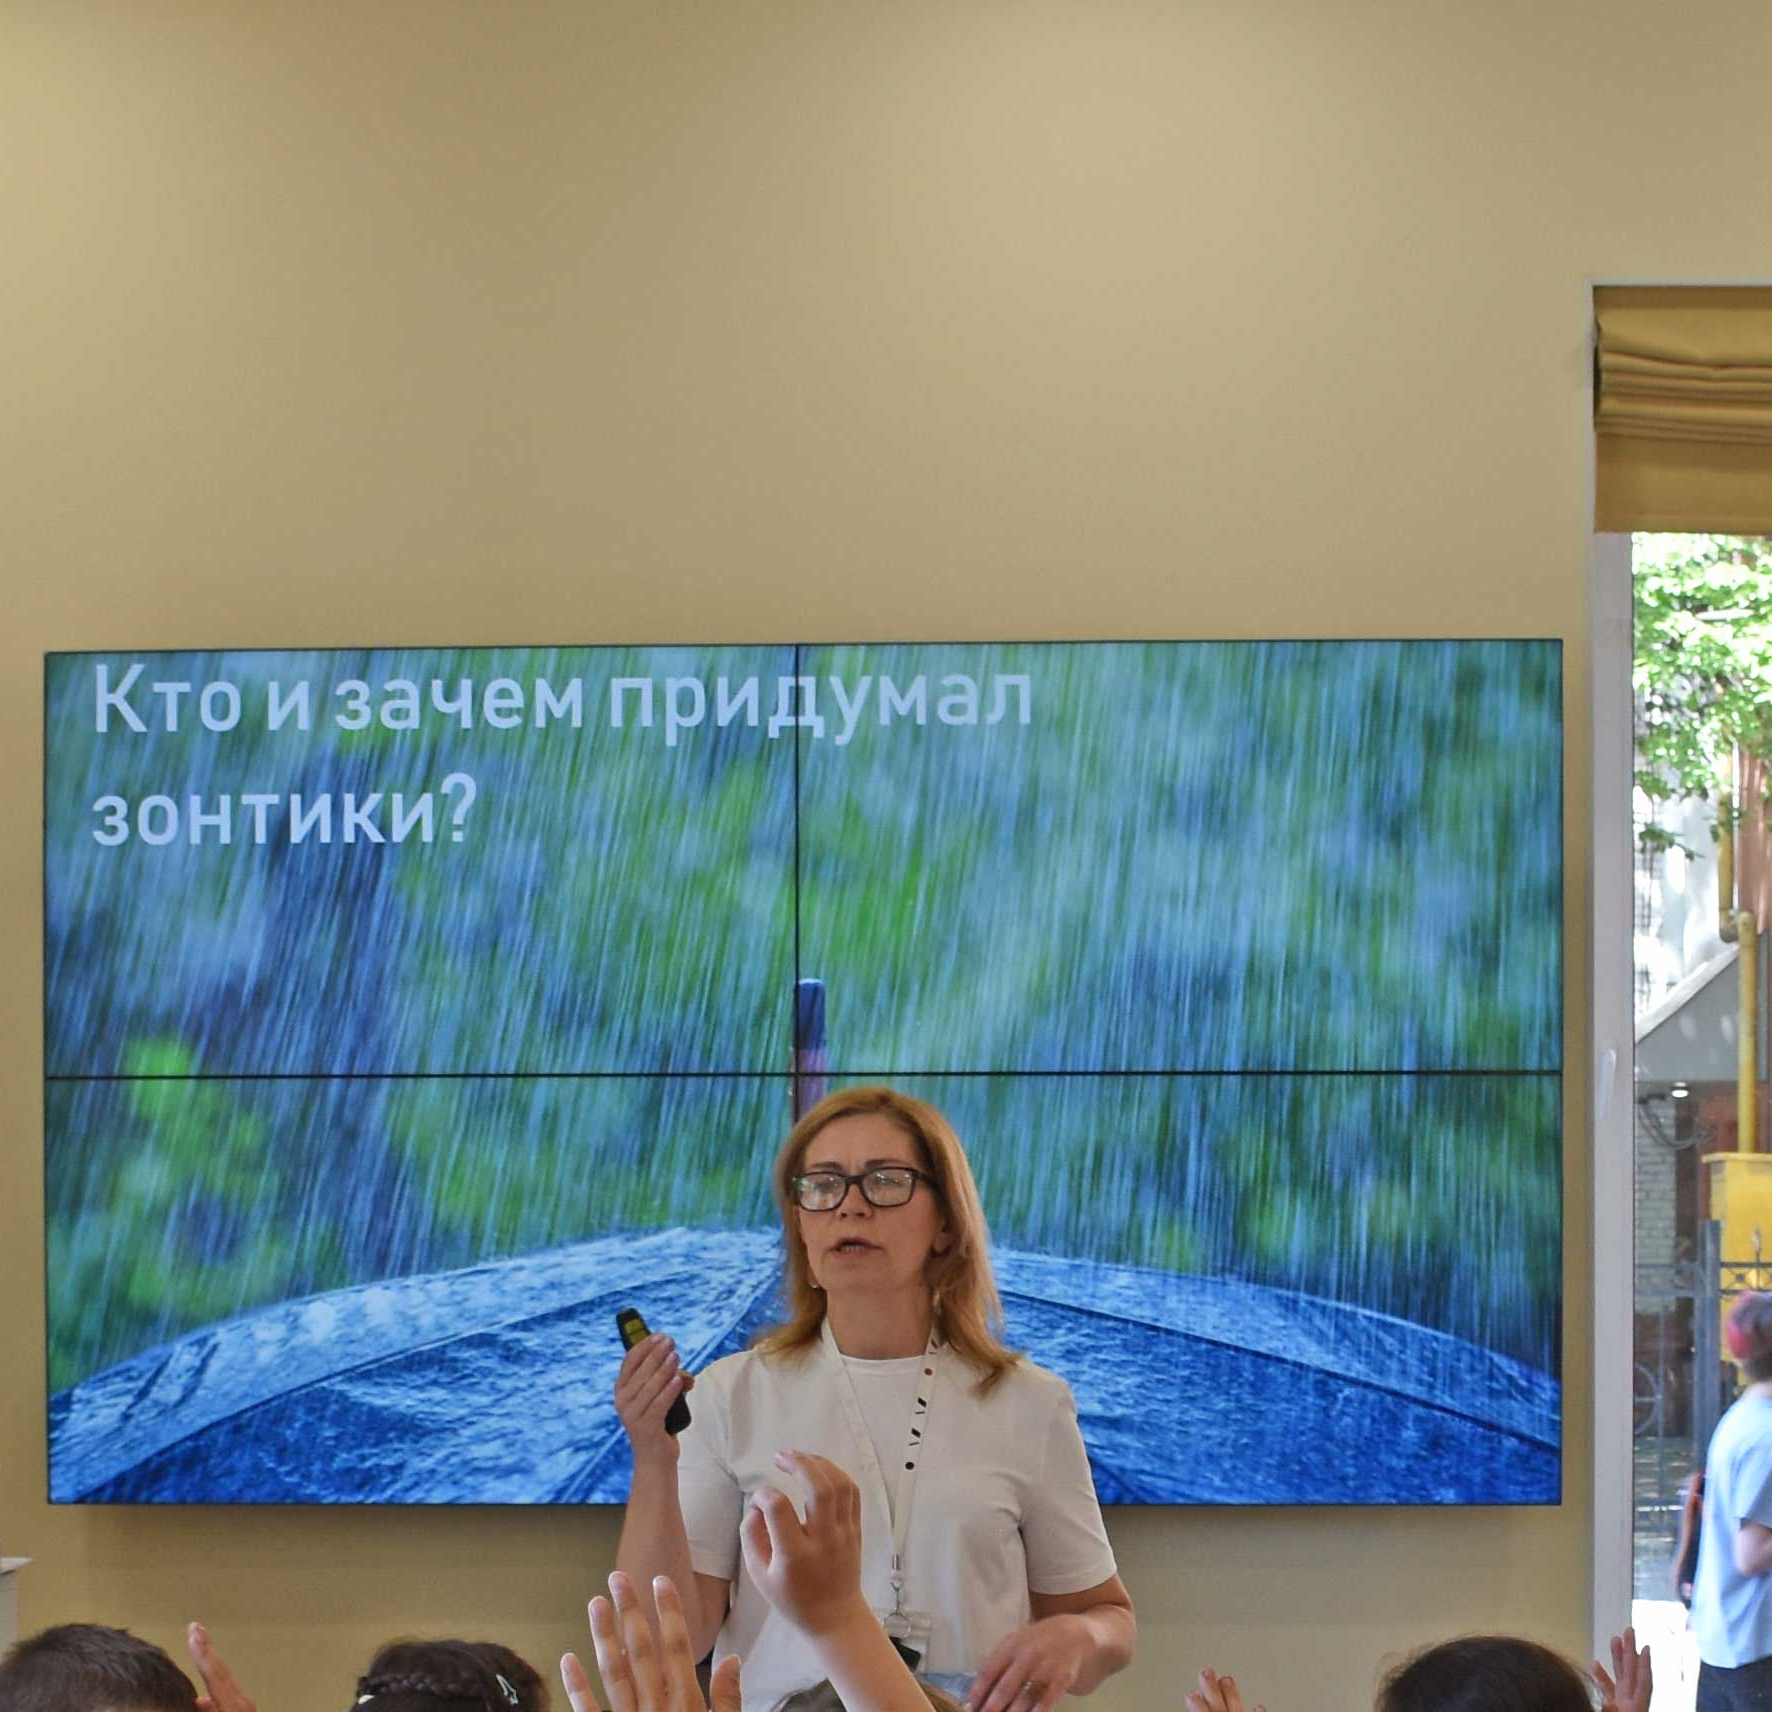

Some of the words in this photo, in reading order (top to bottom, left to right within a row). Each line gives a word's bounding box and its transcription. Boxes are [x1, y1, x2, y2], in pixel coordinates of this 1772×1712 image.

[94, 663, 241, 734] Кто
[267, 681, 309, 731] и
[335, 676, 585, 732] зачем
[610, 669, 1032, 746] придумал
[92, 772, 477, 847] зонтики?
